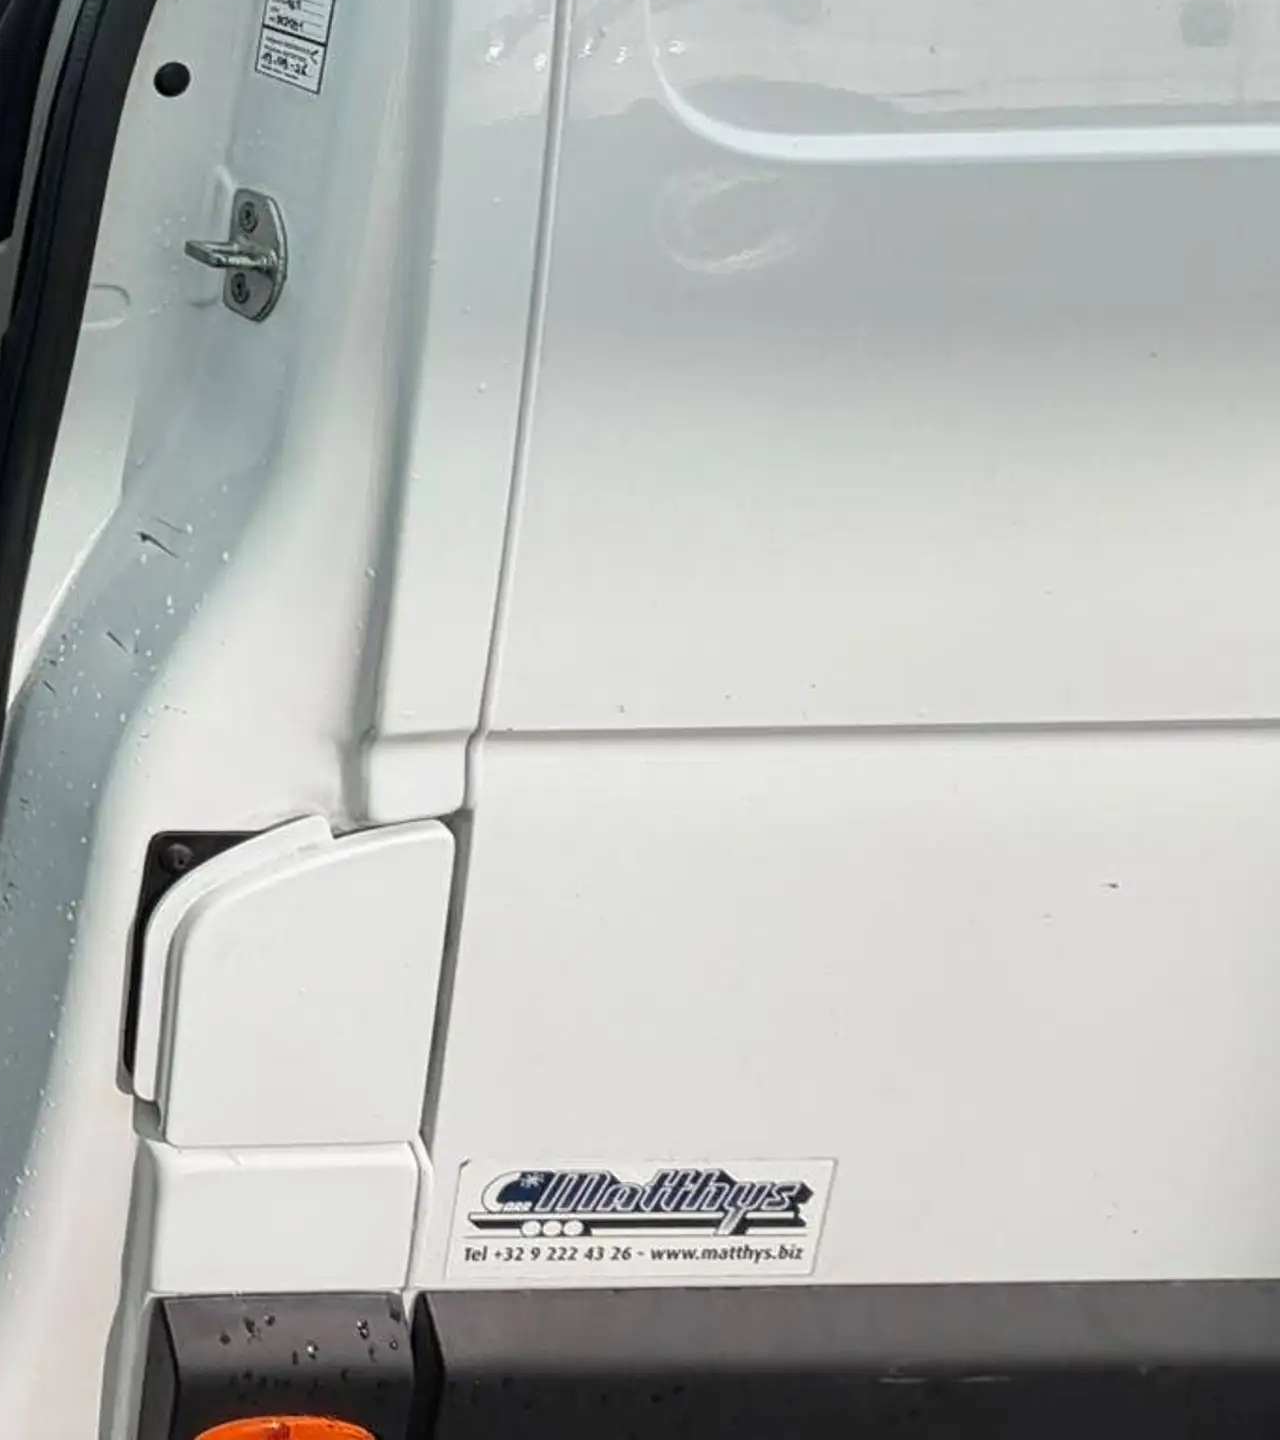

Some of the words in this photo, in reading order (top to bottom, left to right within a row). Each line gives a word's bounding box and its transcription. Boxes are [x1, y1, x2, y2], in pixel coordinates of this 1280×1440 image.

[463, 1245, 489, 1262] Tel
[493, 1246, 525, 1262] +32
[529, 1246, 541, 1261] 9
[545, 1246, 579, 1261] 222
[584, 1246, 605, 1261] 43
[610, 1246, 633, 1261] 26
[650, 1244, 804, 1265] www.matthys.biz
